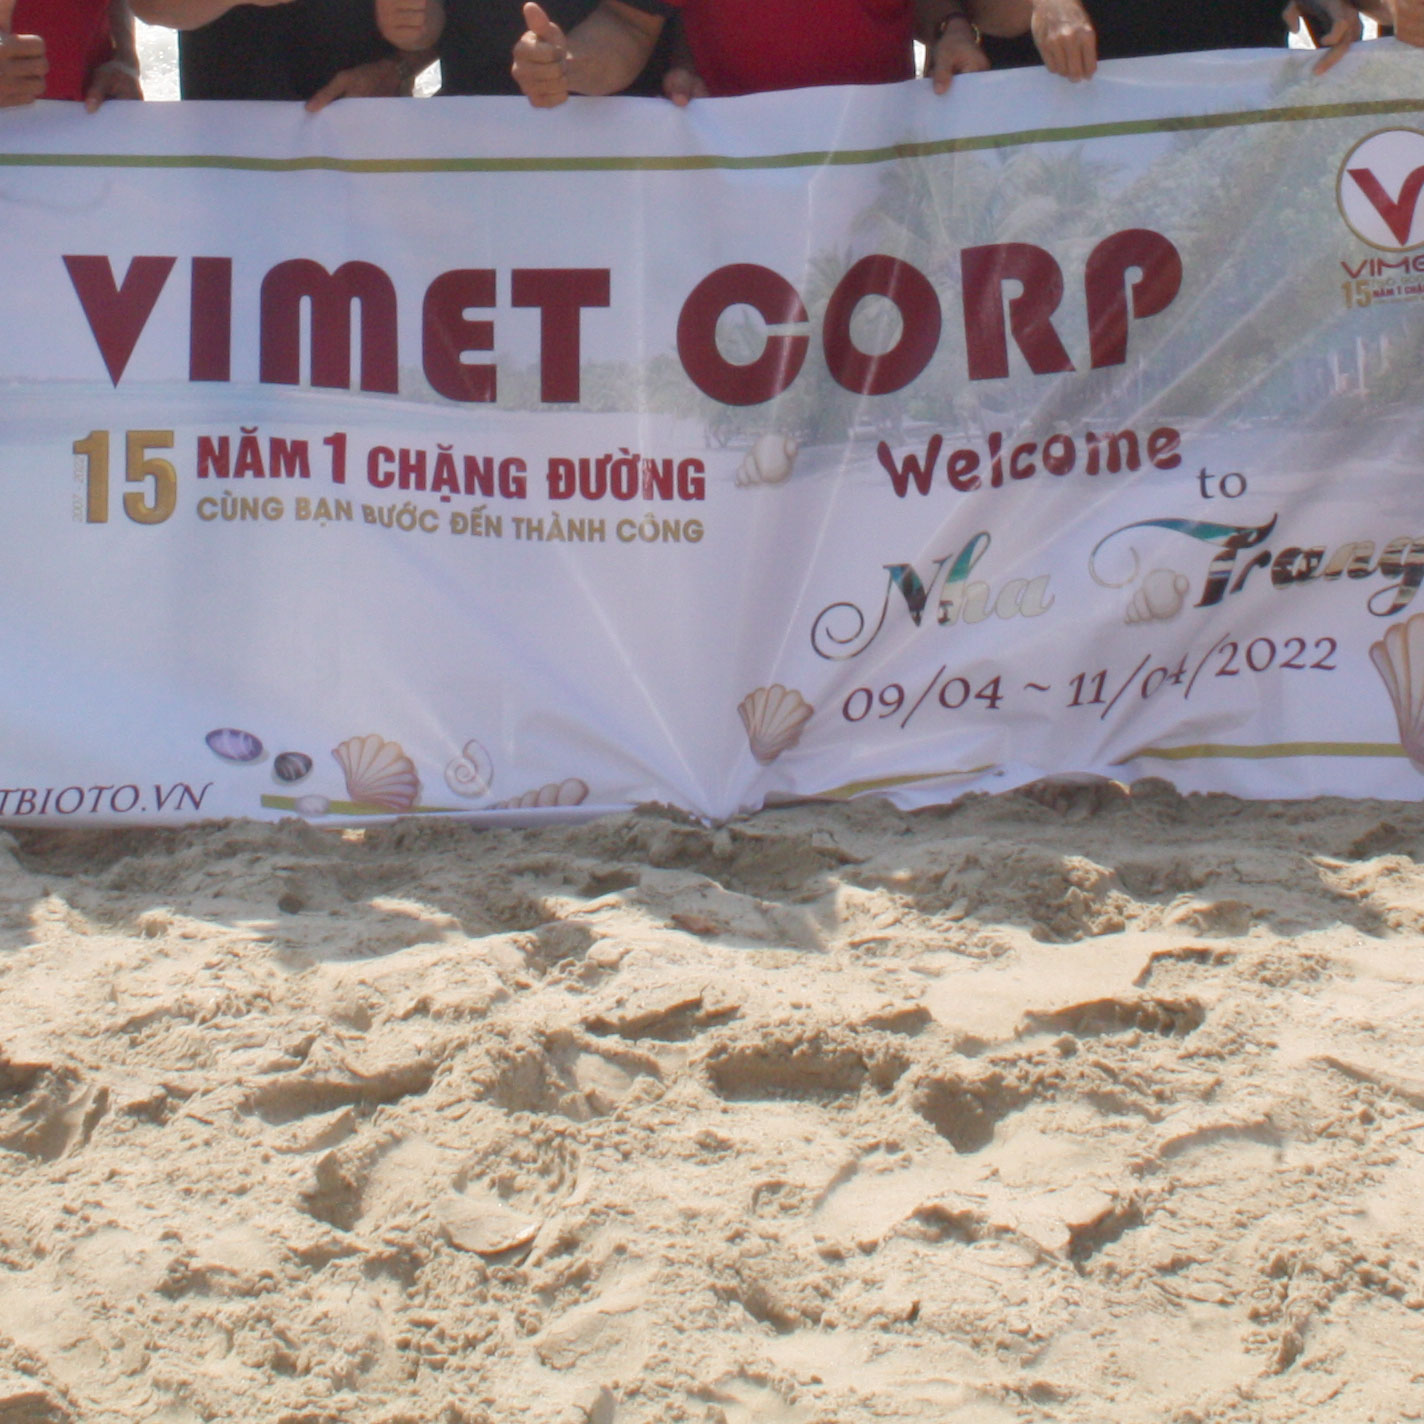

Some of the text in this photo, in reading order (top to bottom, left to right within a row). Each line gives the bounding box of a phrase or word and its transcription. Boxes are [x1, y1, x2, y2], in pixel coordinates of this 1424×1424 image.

[62, 228, 1183, 406] VIMET CORP
[1340, 279, 1372, 309] 15
[72, 430, 177, 525] 15
[196, 426, 311, 479] NĂM
[323, 432, 347, 484] 1
[366, 442, 527, 503] CHẶNG
[546, 447, 706, 501] ĐƯỜNG
[877, 426, 1183, 498] Welcome
[1197, 465, 1248, 500] to
[196, 490, 705, 543] CÙNG BẠN BƯỚC ĐẾN THÀNH CÔNG
[810, 530, 1056, 662] Nha
[841, 664, 1004, 729] 09/04
[1066, 632, 1338, 720] 11/04/2022
